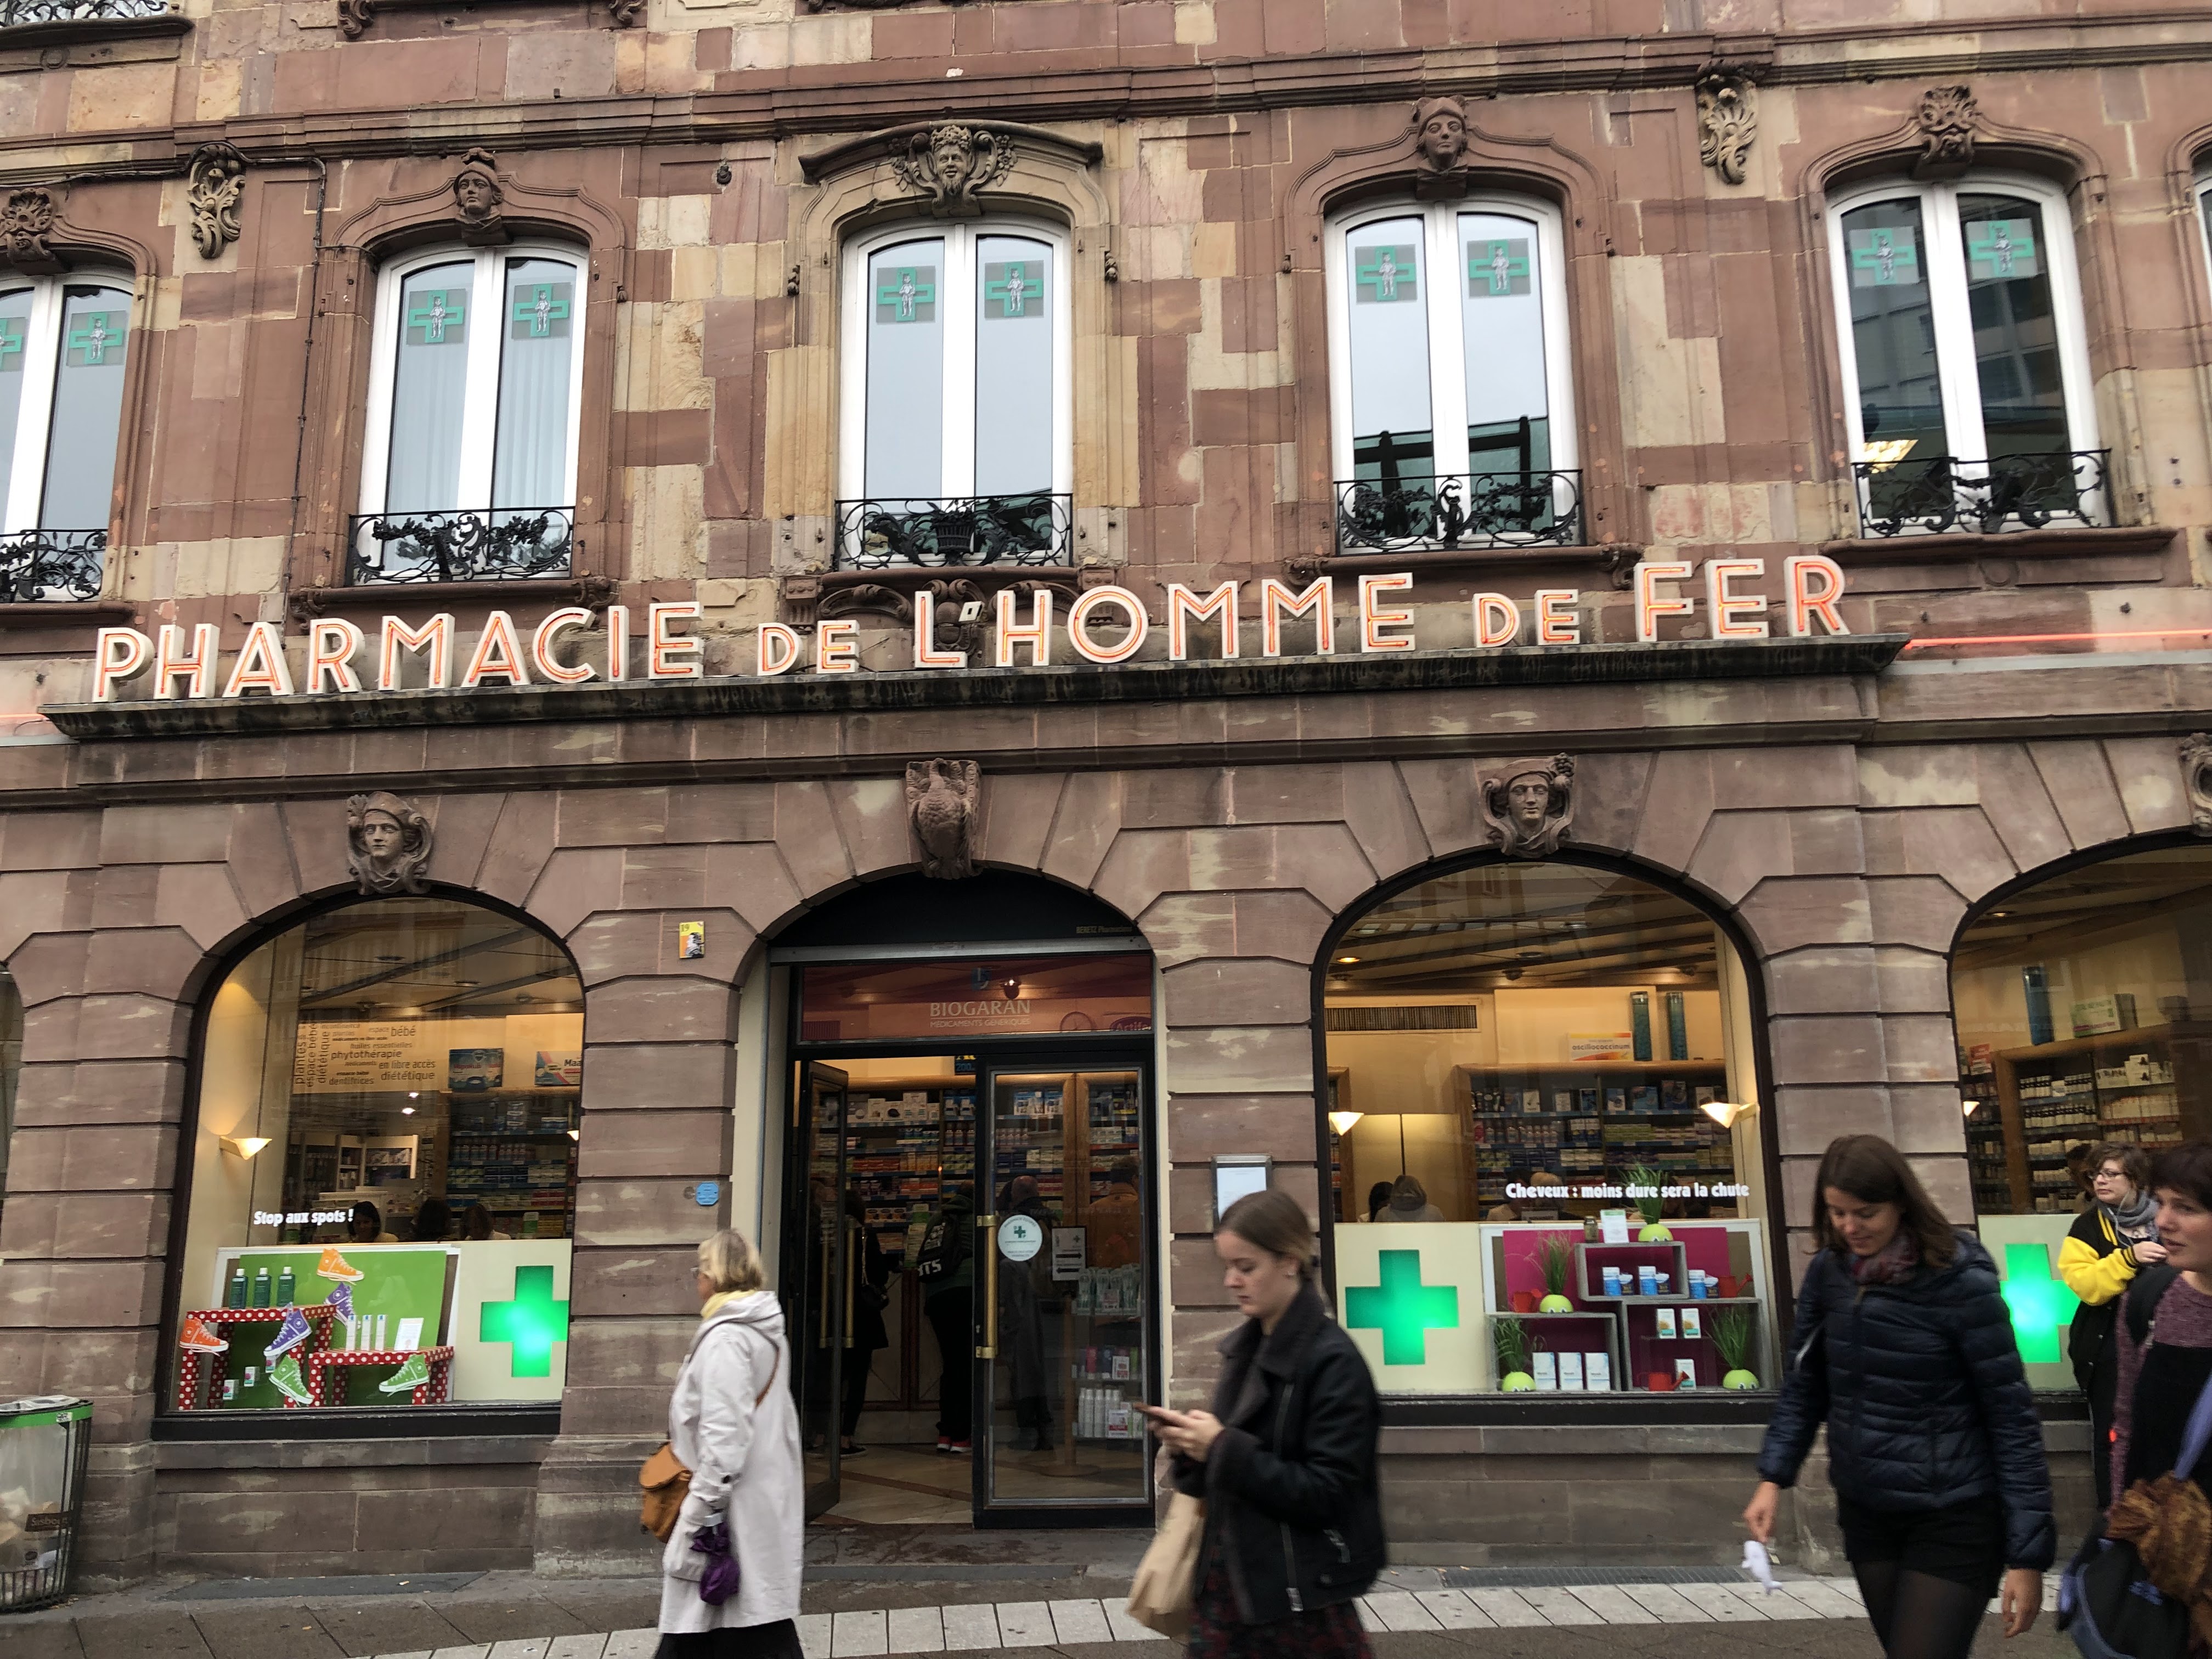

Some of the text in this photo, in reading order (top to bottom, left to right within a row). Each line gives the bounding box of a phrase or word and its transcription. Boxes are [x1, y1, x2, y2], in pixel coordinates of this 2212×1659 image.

[92, 555, 1851, 702] PHARMACIE DE L'HOMME DE FER
[681, 924, 690, 932] 19
[930, 1000, 1031, 1017] BIOGARAN
[391, 1025, 417, 1037] bébé
[331, 1049, 402, 1060] phytothérapie
[294, 1041, 306, 1085] plantes
[391, 1060, 410, 1069] libre
[412, 1059, 436, 1069] accès
[329, 1077, 374, 1086] dentifrices
[380, 1070, 436, 1081] diététique
[1505, 1183, 1570, 1198] Cheveux
[1581, 1182, 1622, 1198] moins
[1626, 1182, 1658, 1198] dure
[1661, 1185, 1691, 1198] sera
[1694, 1182, 1708, 1197] la
[1711, 1182, 1750, 1197] chute
[253, 1211, 284, 1227] Stop
[285, 1212, 309, 1223] aux
[311, 1210, 346, 1226] spots
